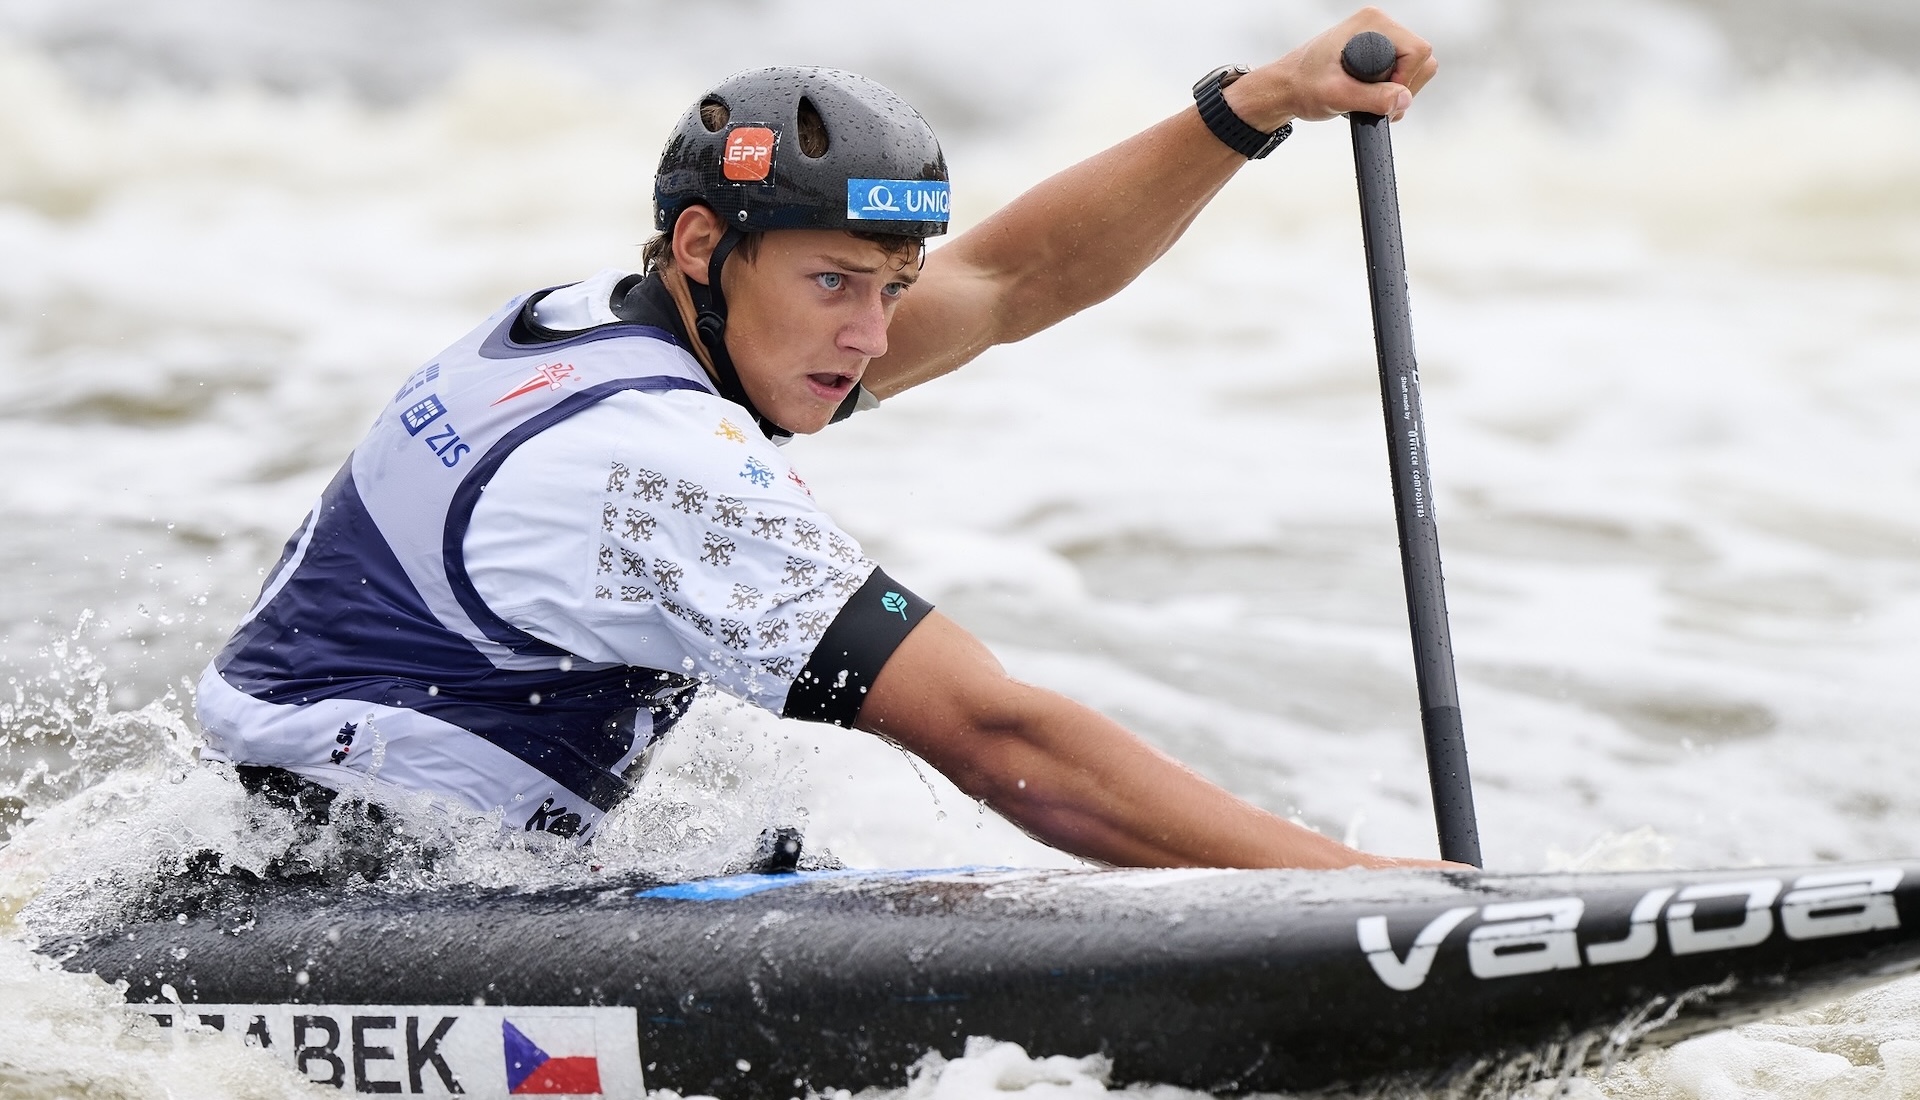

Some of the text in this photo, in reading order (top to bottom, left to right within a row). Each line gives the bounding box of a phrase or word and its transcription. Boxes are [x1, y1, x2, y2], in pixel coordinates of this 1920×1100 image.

[1402, 393, 1410, 411] made
[1403, 411, 1411, 420] by
[424, 423, 471, 468] ZIS
